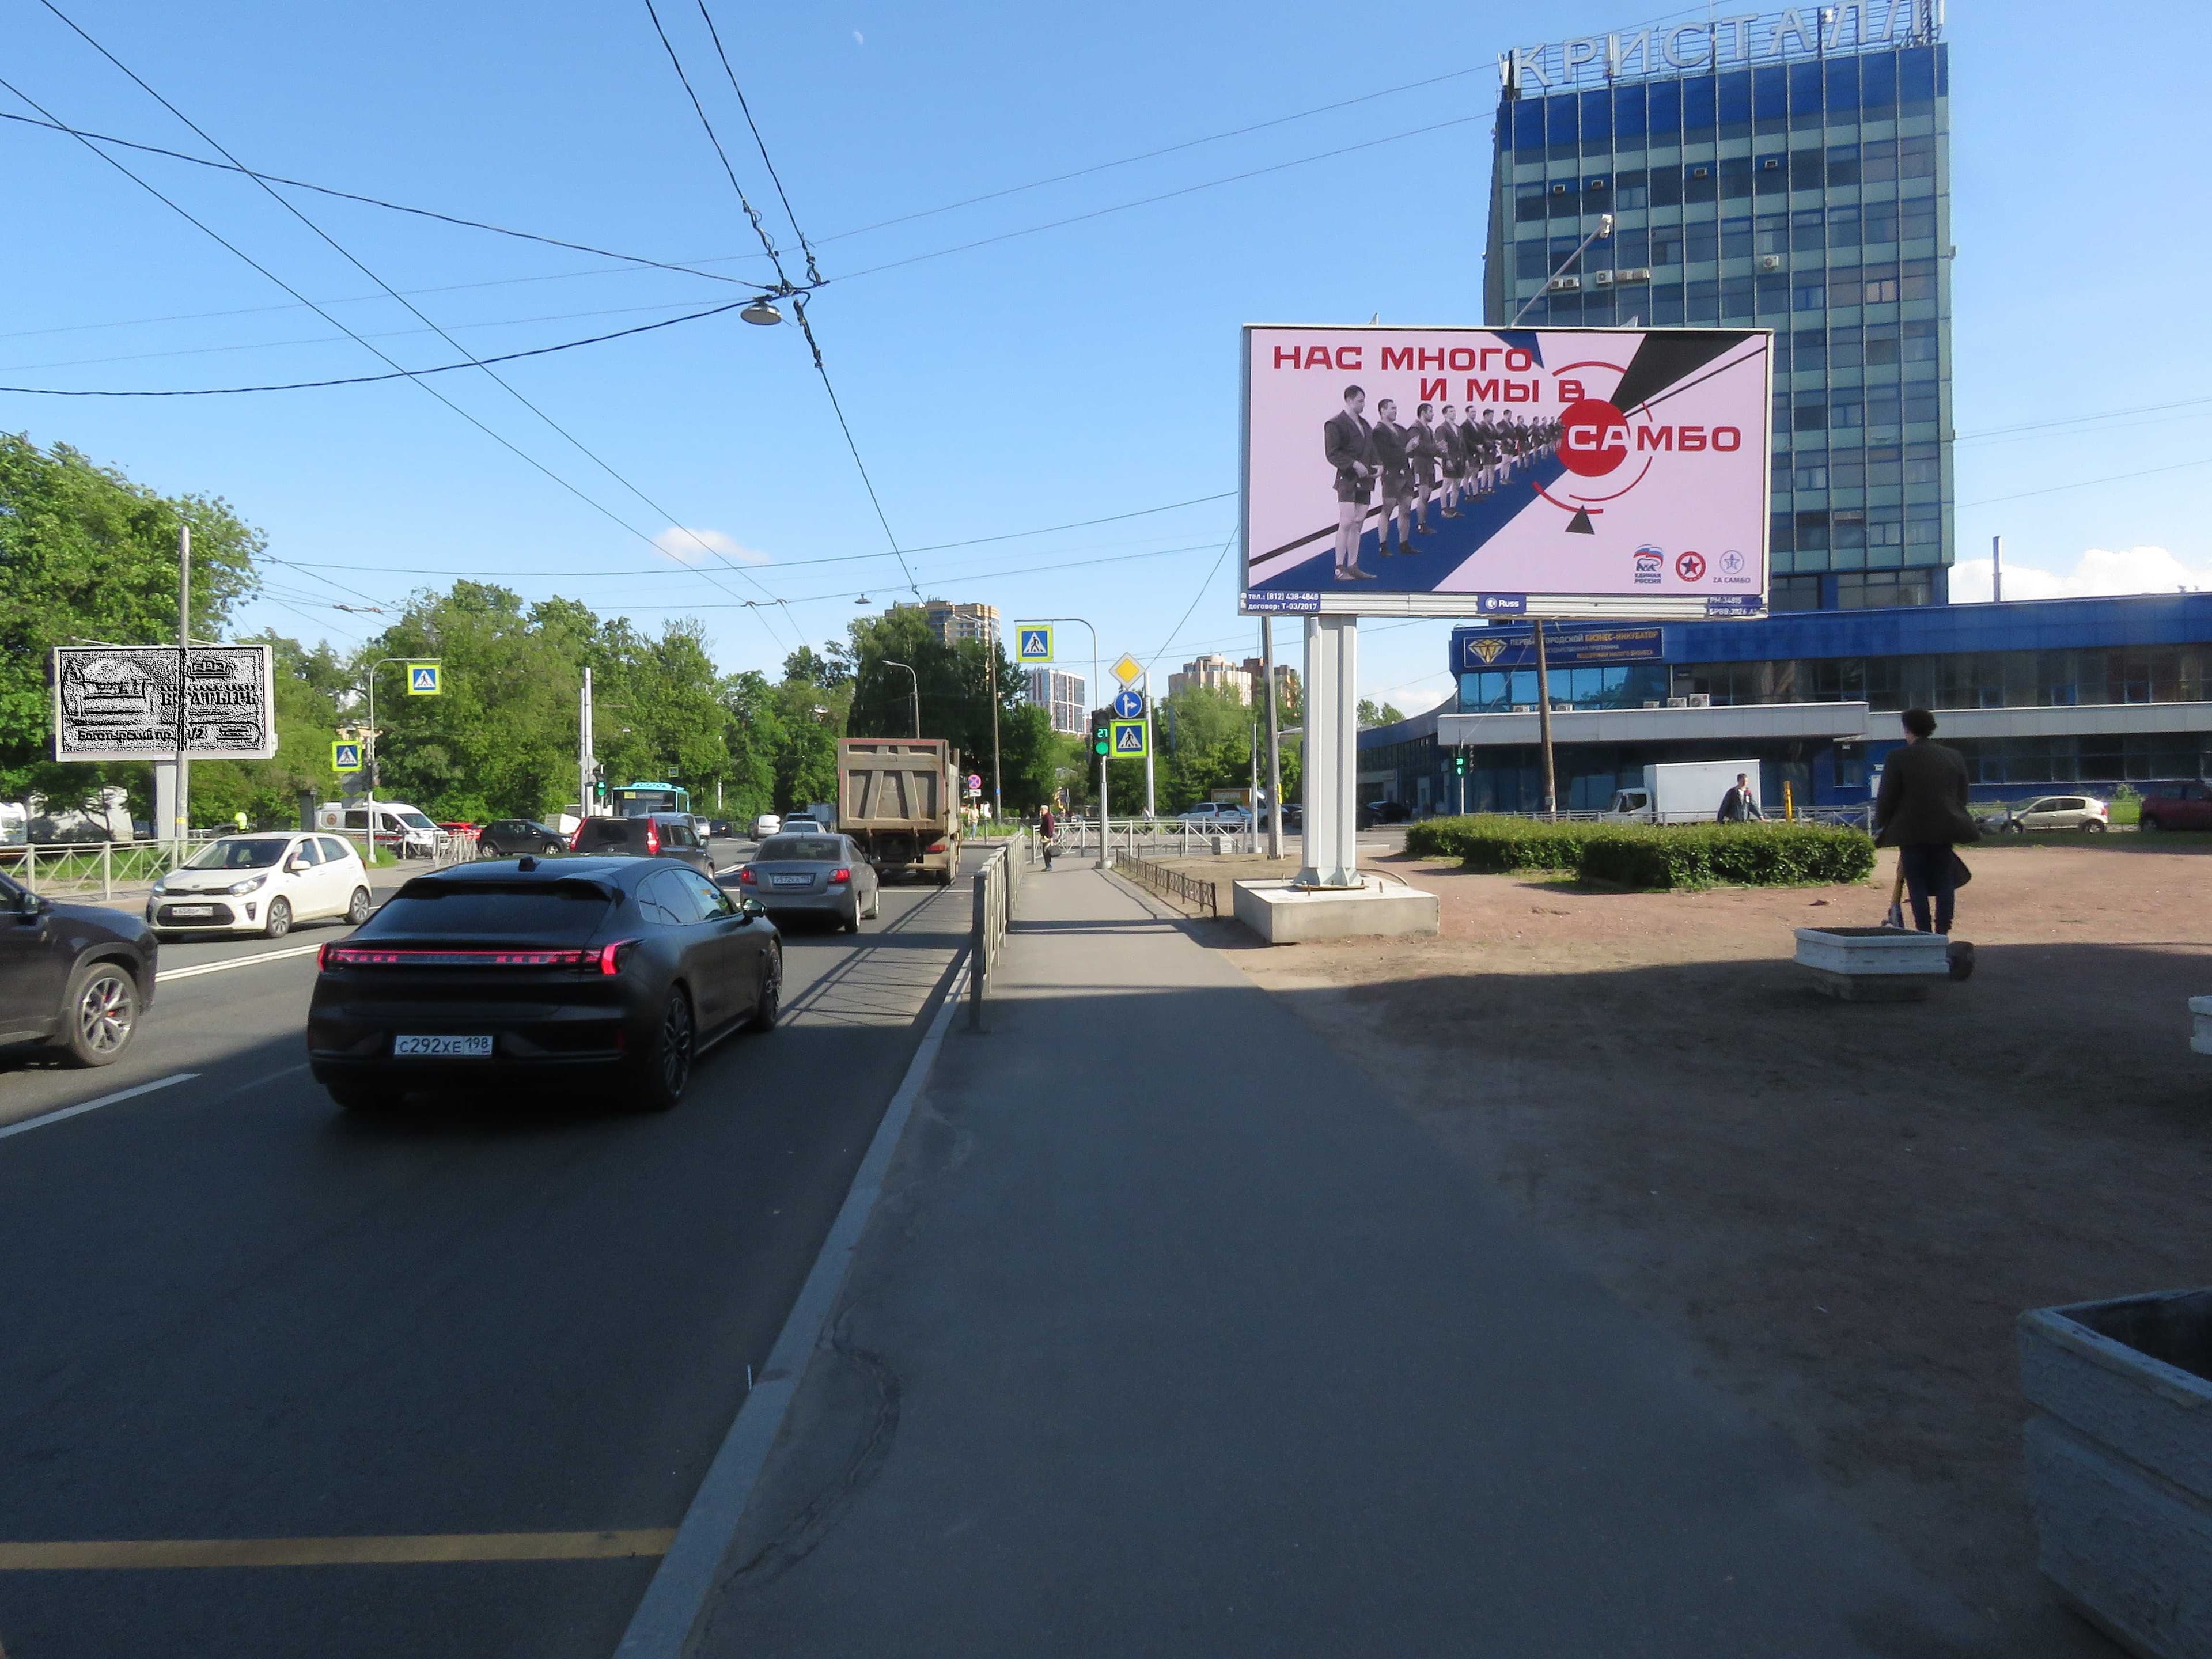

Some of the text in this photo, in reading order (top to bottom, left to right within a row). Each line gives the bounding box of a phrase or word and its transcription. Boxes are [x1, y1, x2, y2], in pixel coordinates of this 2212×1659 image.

[1274, 346, 1532, 372] НАС МНОГО
[1420, 378, 1585, 403] И МЫ В
[1567, 425, 1741, 452] САМБО
[1267, 593, 1285, 601] (812)
[1498, 600, 1520, 608] Russ
[1544, 634, 1584, 645] ОРОДСКОЙ
[1097, 728, 1108, 738] 27
[400, 1037, 488, 1054] С292ХЕ 198
